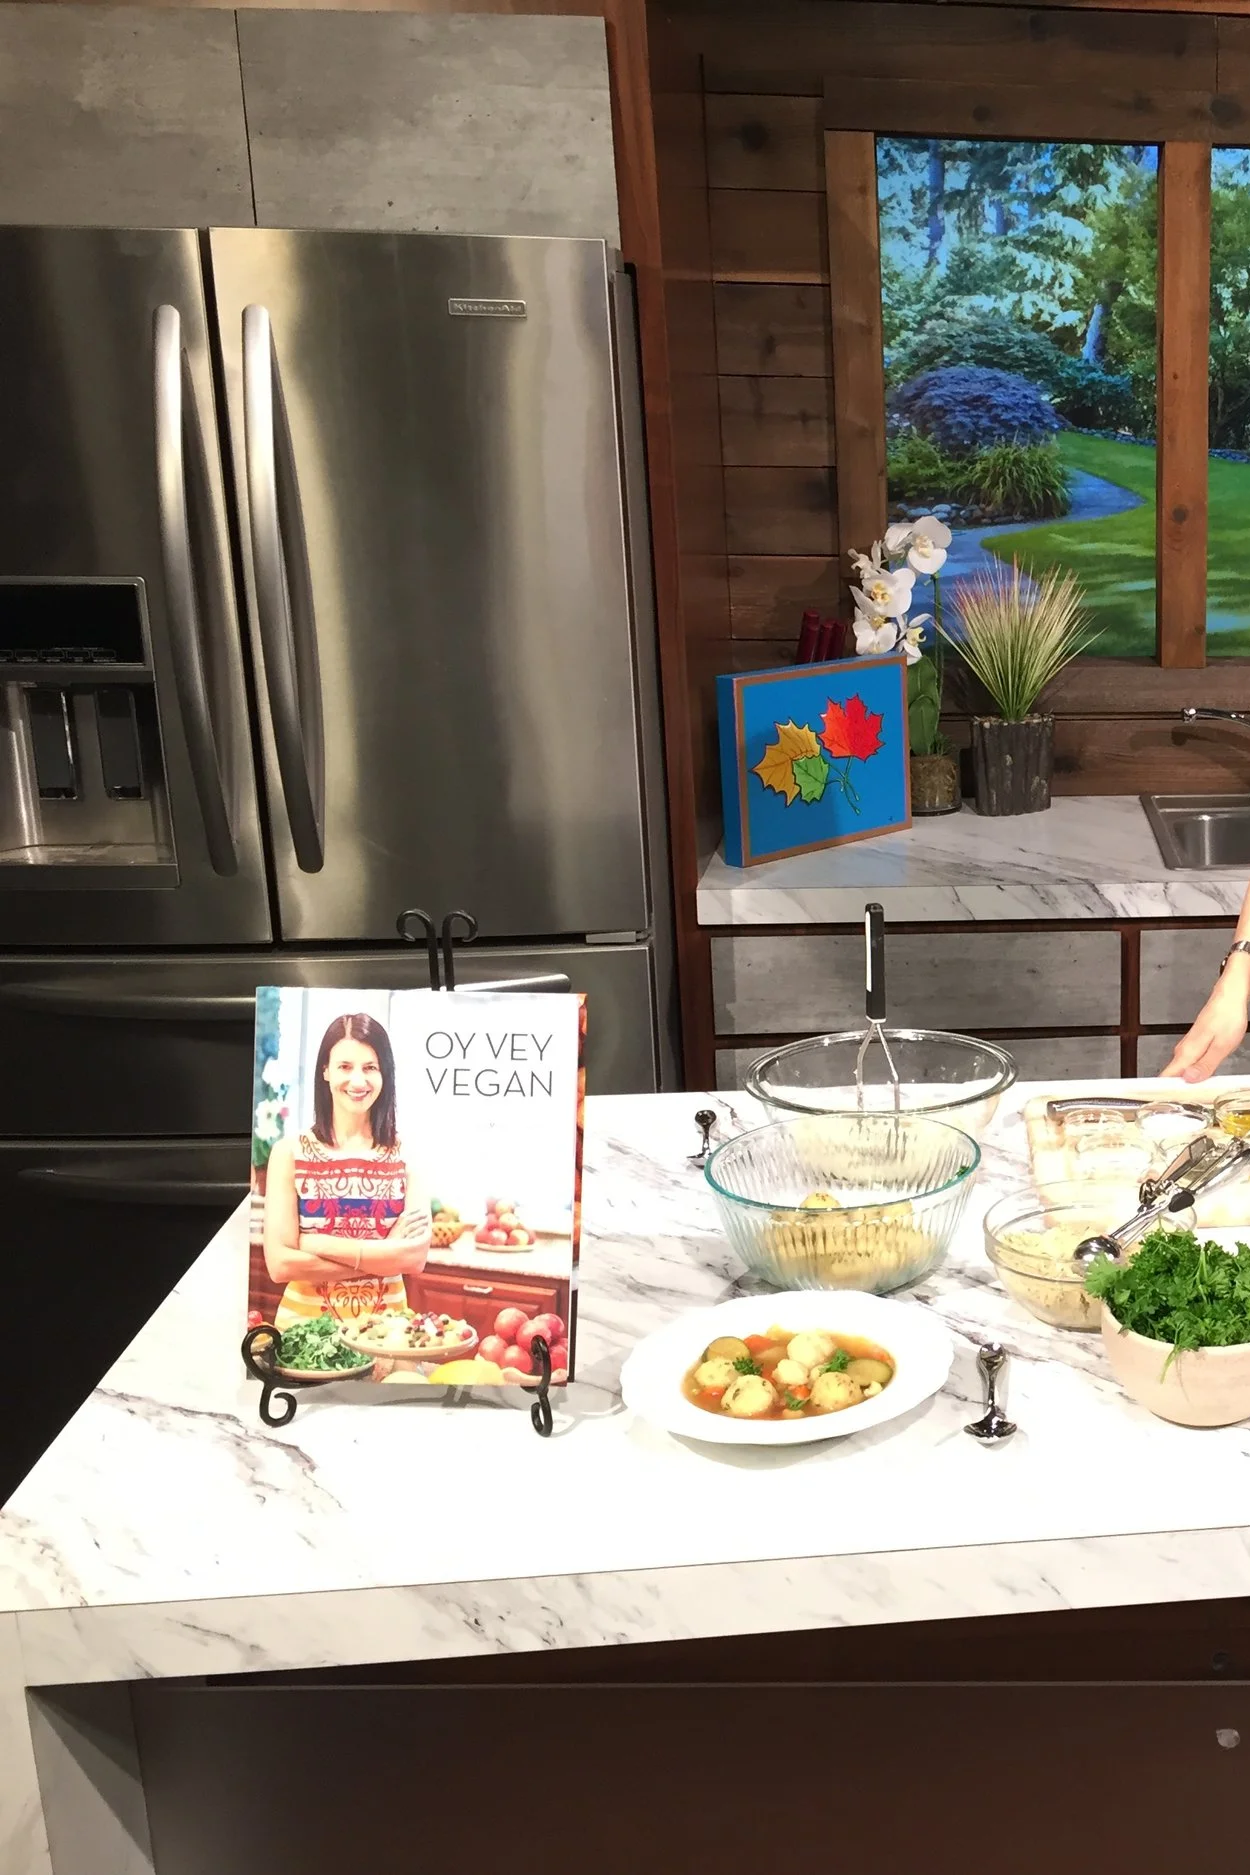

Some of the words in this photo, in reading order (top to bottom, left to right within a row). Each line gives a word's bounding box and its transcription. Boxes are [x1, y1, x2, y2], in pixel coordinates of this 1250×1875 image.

[425, 1031, 476, 1060] OY
[486, 1033, 553, 1061] VEY
[425, 1067, 553, 1098] VEGAN
